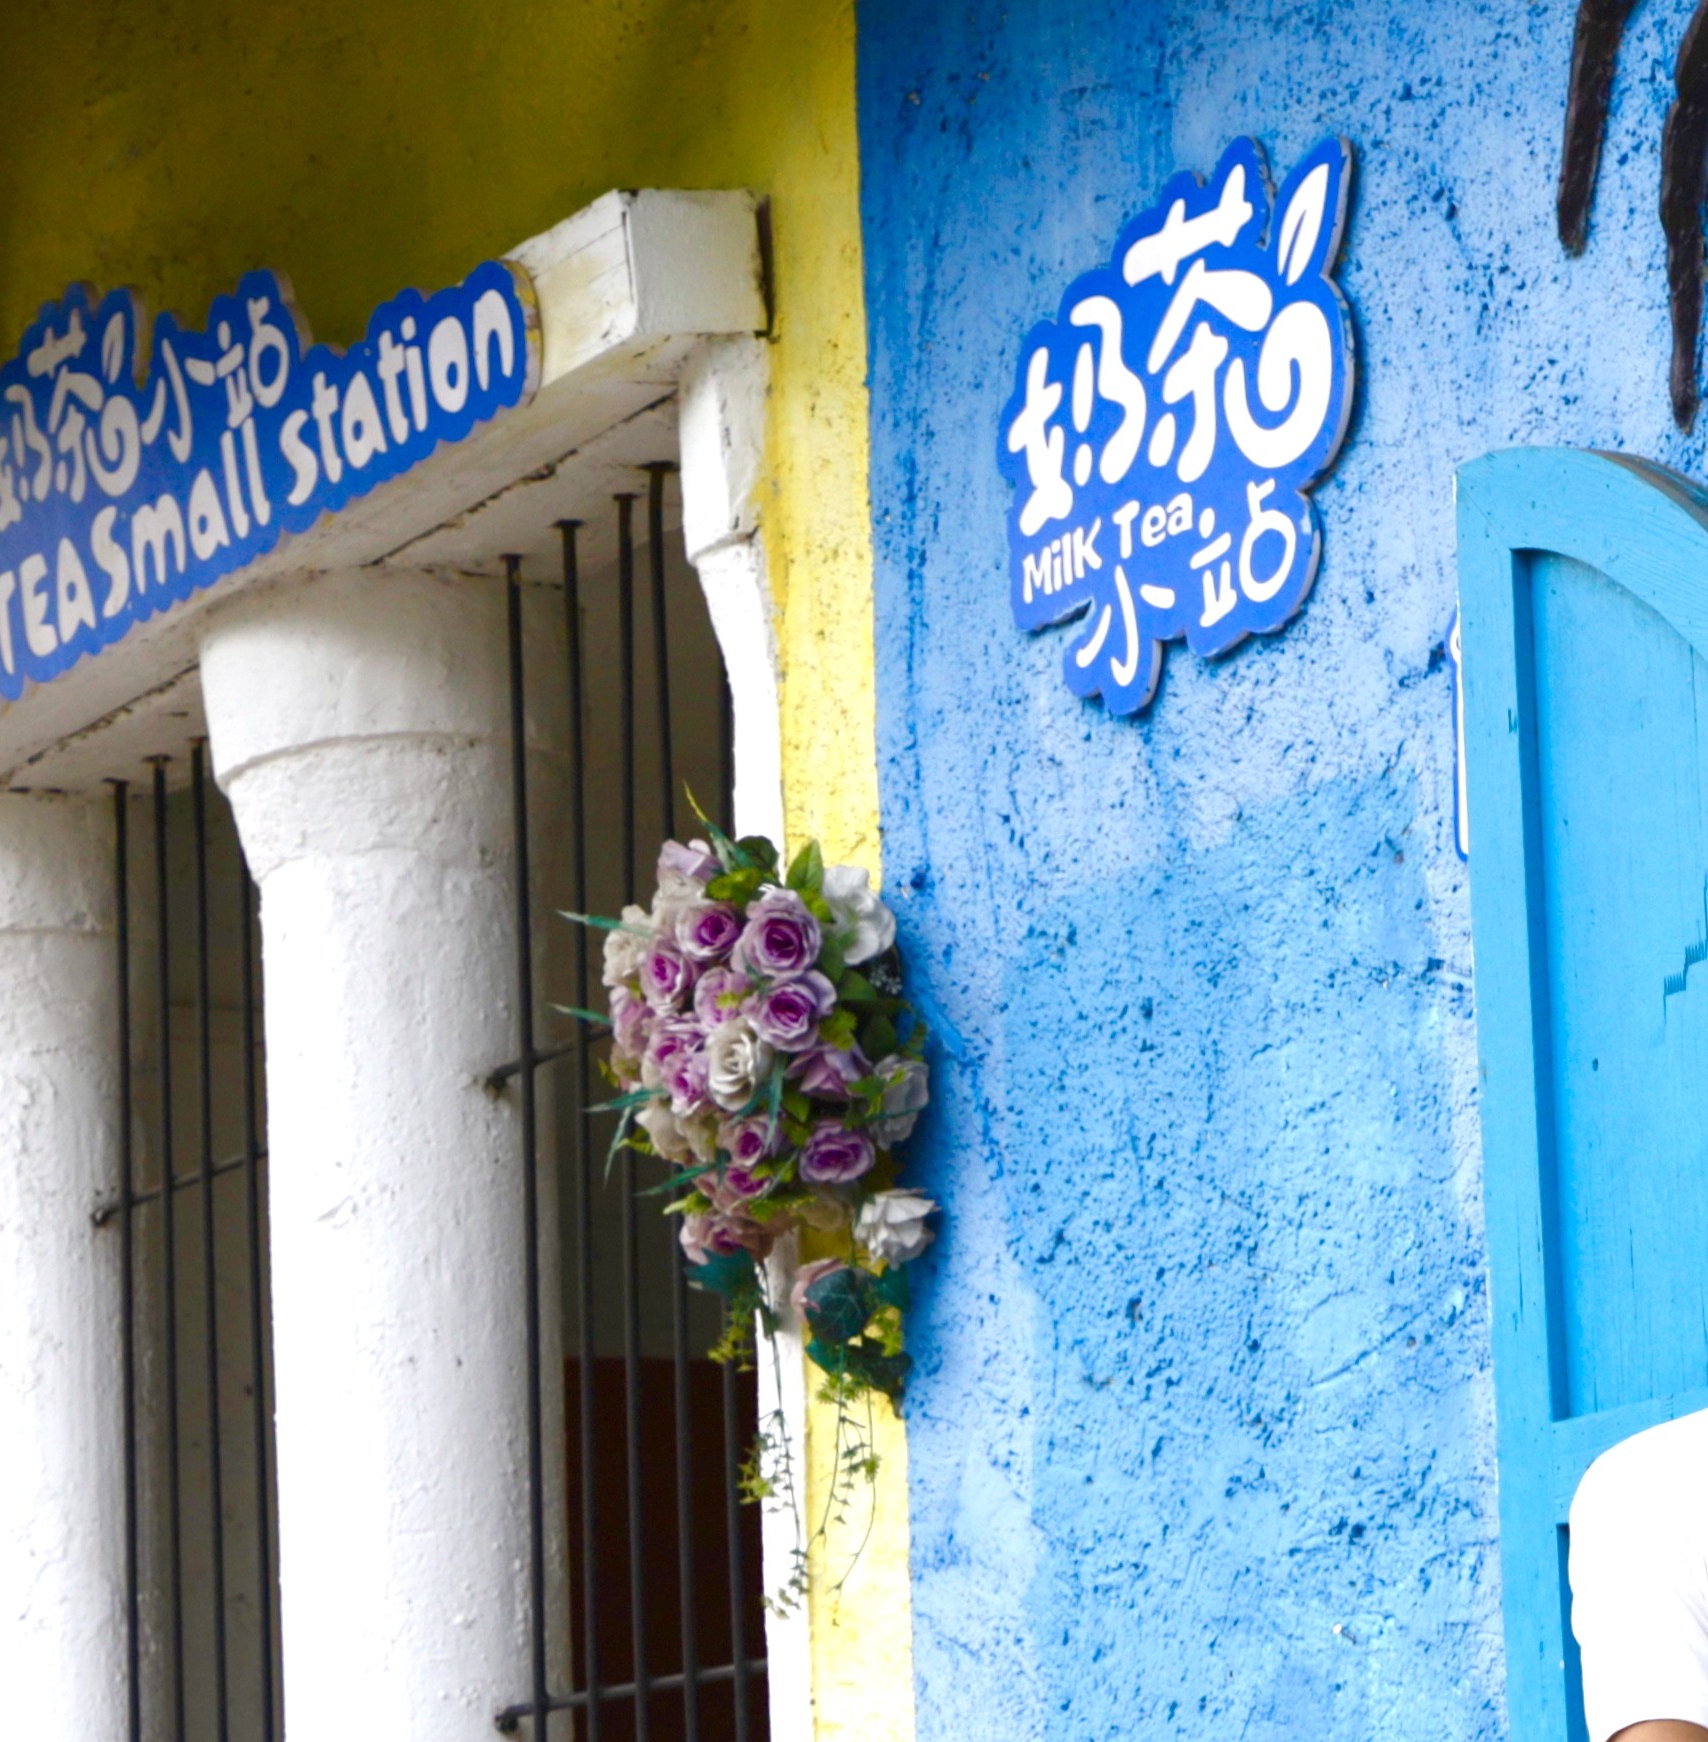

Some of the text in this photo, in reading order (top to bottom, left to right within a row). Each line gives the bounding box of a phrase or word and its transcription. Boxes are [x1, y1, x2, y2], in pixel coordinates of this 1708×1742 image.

[1008, 163, 1331, 537] 奶茶
[1077, 478, 1295, 687] 小站
[1112, 493, 1193, 559] Tea
